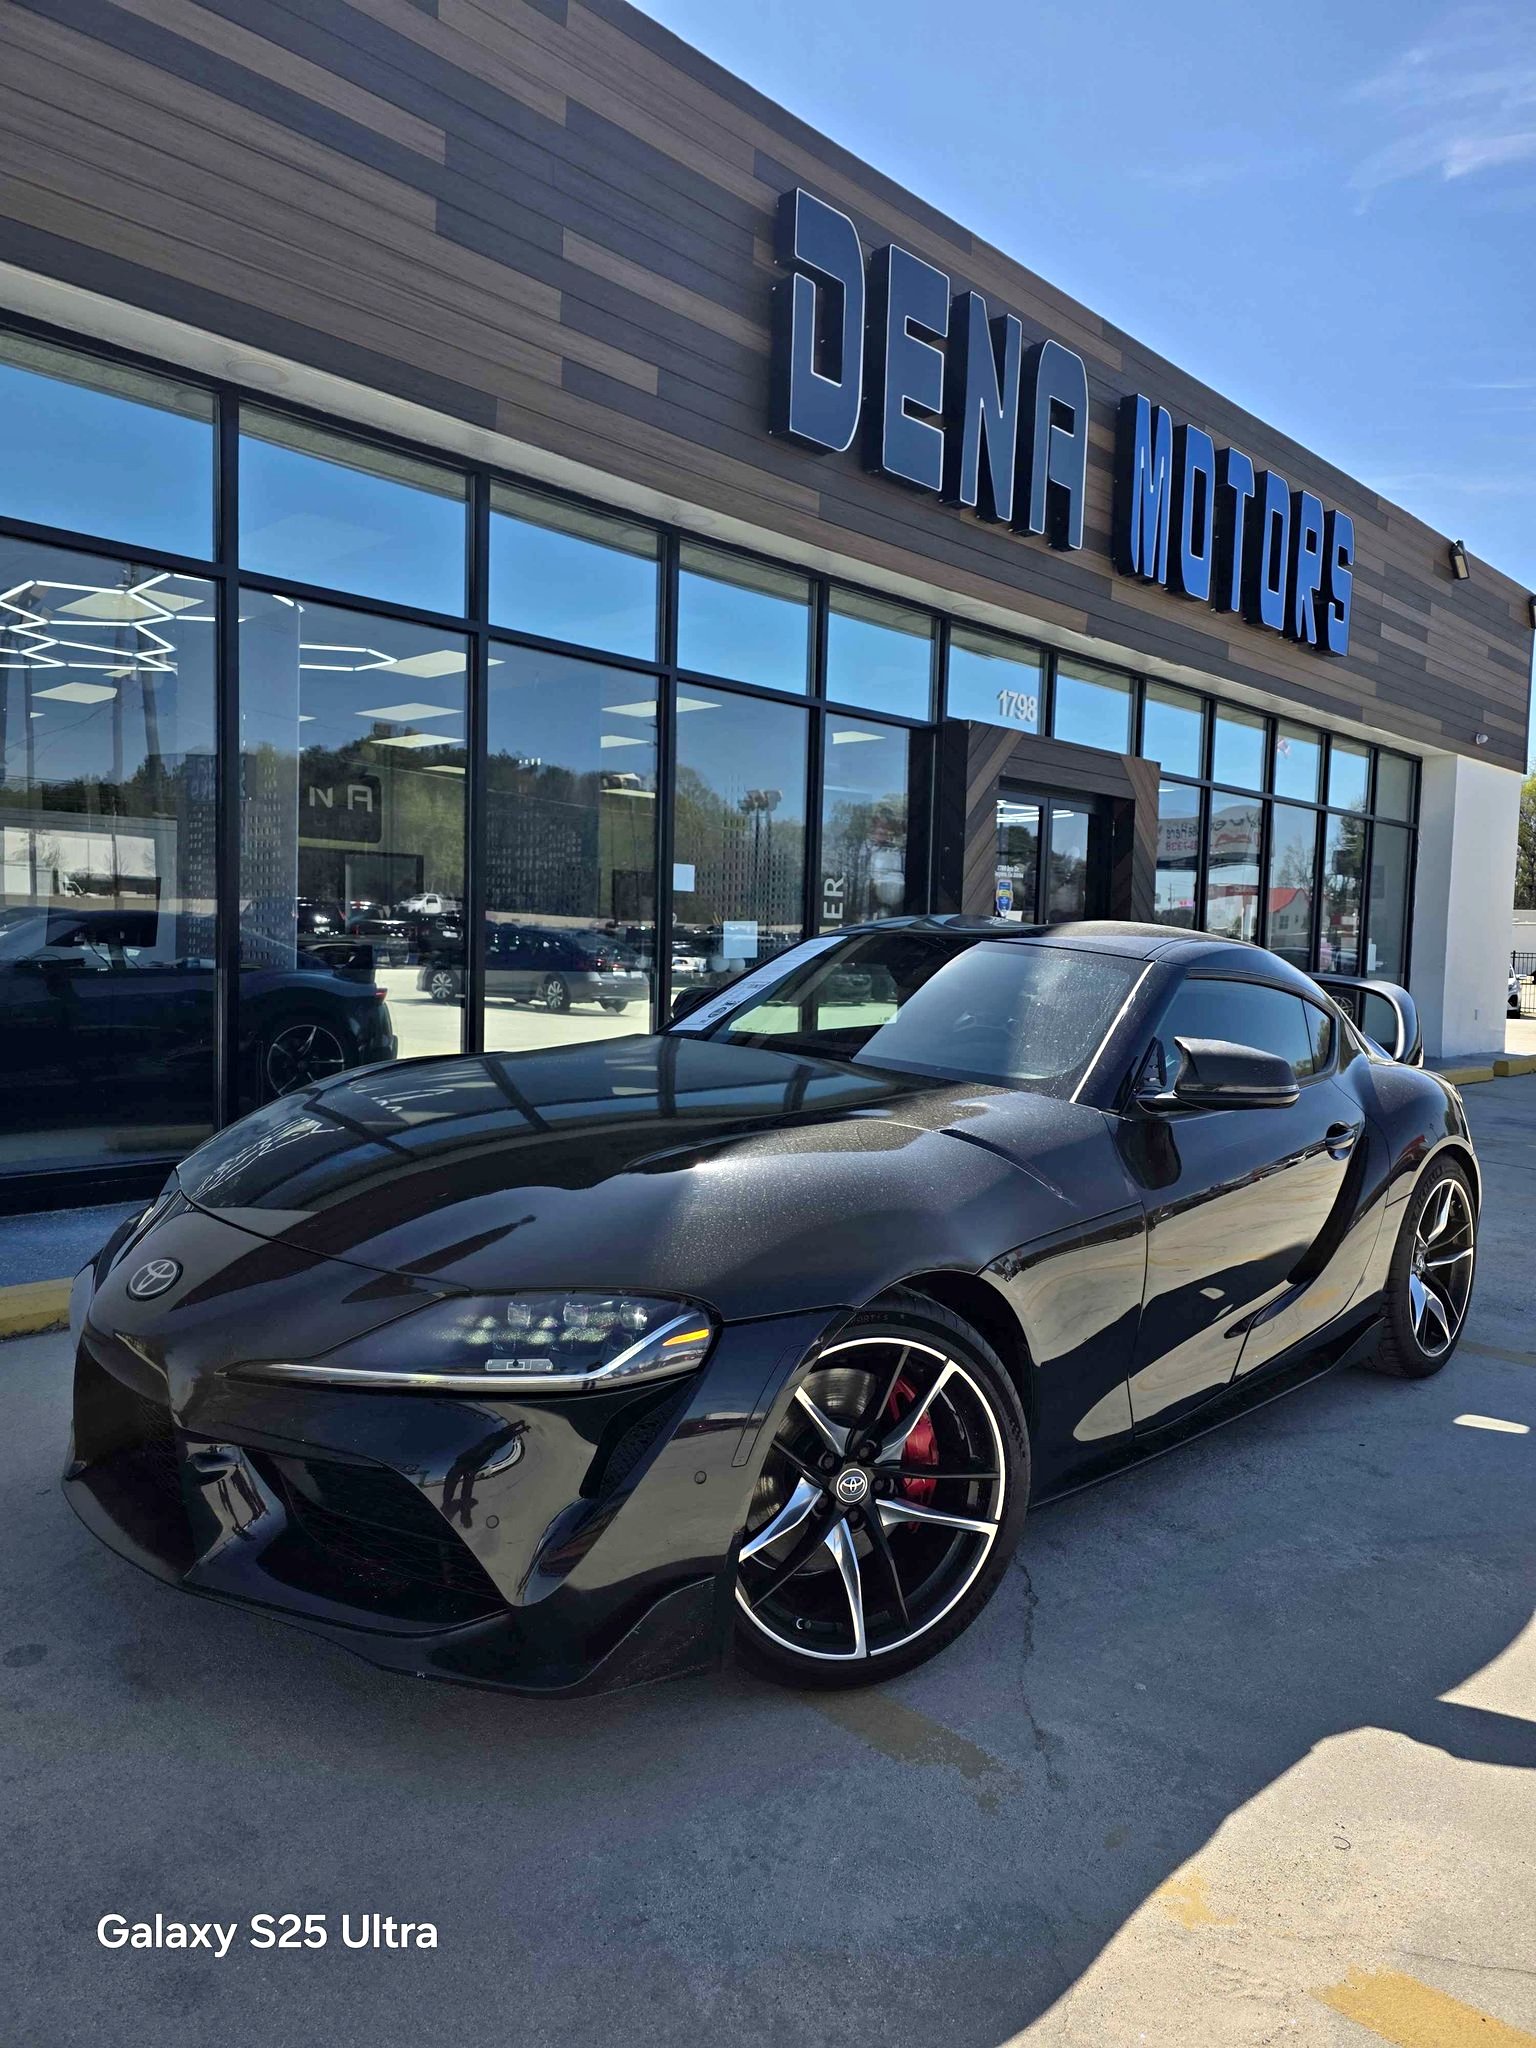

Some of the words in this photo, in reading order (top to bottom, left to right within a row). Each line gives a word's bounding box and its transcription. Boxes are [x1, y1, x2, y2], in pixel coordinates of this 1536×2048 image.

[771, 186, 1089, 551] DENA
[1117, 393, 1356, 658] MOTORS
[997, 688, 1038, 722] 1798
[823, 873, 845, 928] ER
